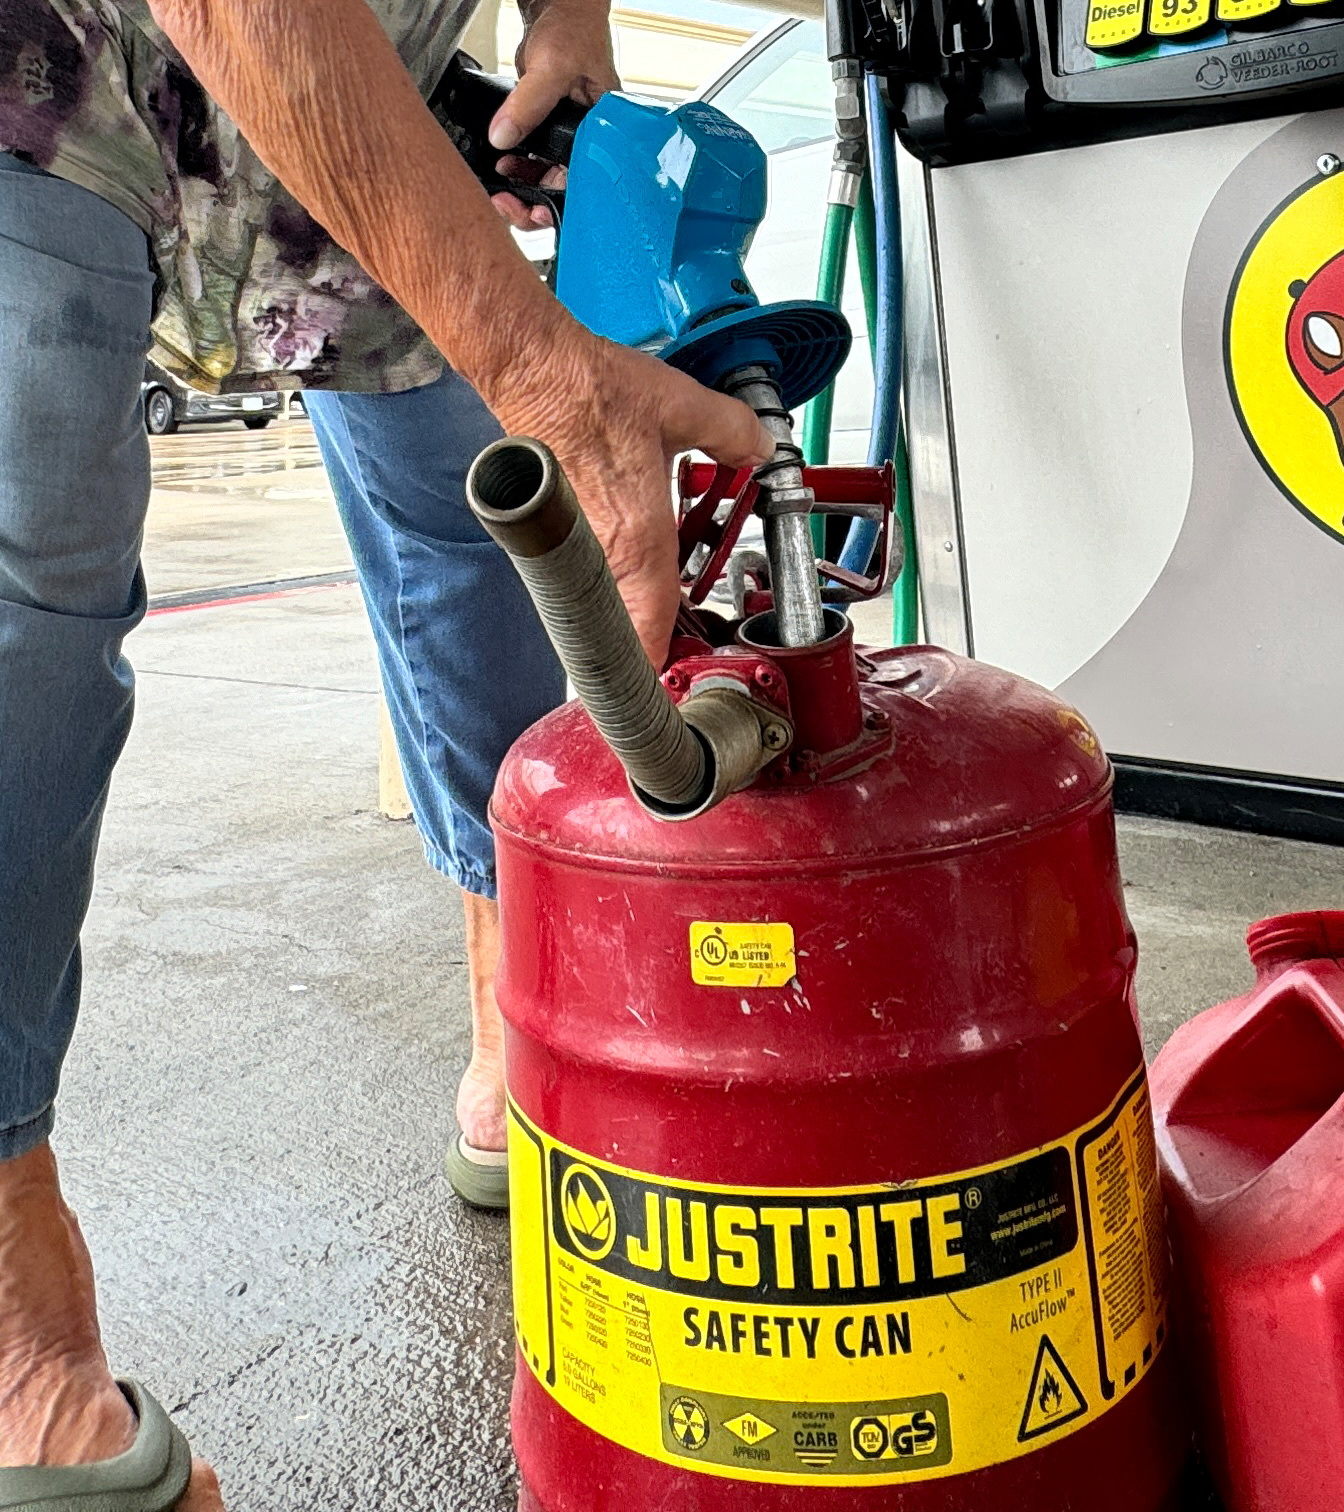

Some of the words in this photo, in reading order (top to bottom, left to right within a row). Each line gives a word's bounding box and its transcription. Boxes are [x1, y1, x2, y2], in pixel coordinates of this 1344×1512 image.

[1231, 42, 1310, 66] GILBARCO
[1231, 54, 1338, 83] VEEDER-ROOT
[743, 950, 769, 960] LISTED
[1019, 1272, 1050, 1303] TYPE
[1053, 1267, 1062, 1290] II
[683, 1307, 821, 1359] SAFETY
[835, 1311, 913, 1359] CAN
[792, 1411, 835, 1421] ACCEPTED
[741, 1422, 758, 1438] FM
[802, 1421, 826, 1430] under
[892, 1411, 936, 1456] GS
[794, 1431, 838, 1448] CARB
[733, 1445, 770, 1462] APPROVED
